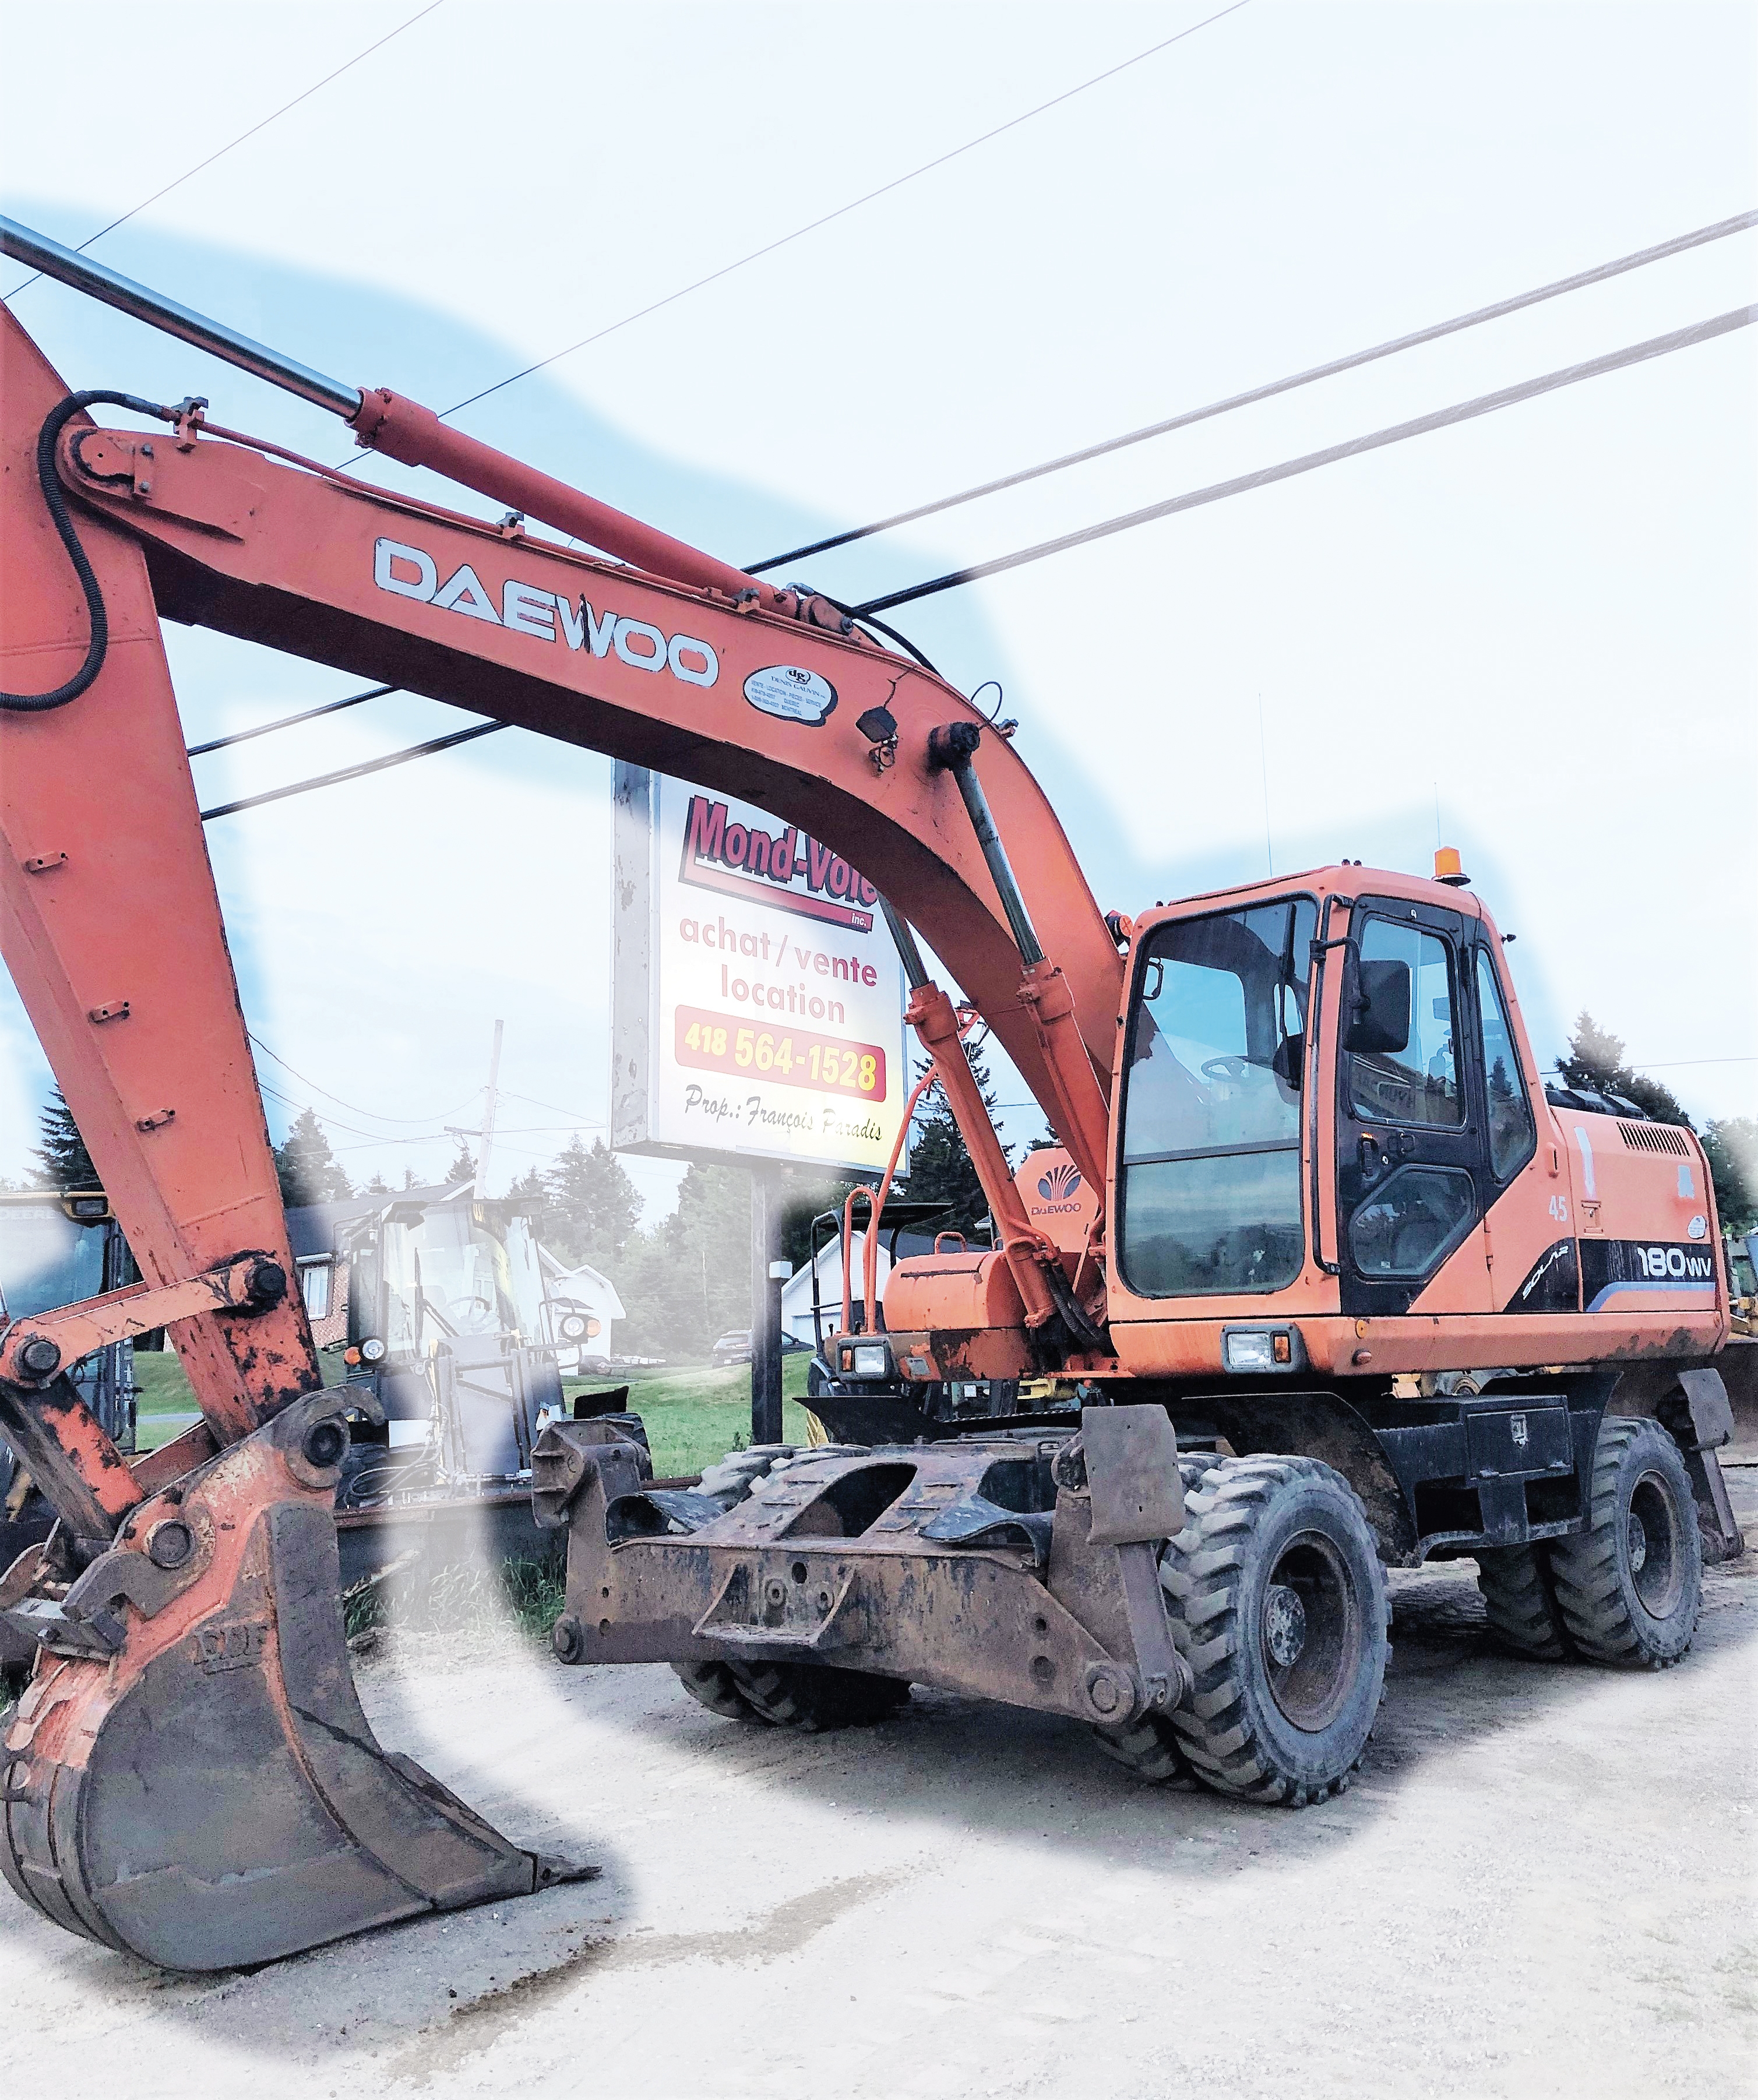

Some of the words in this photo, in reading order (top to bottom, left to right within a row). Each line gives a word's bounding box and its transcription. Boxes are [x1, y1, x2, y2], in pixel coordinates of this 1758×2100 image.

[374, 536, 720, 688] DAEWOO
[771, 676, 792, 687] DENIS
[851, 912, 867, 926] inc.
[721, 964, 845, 1024] location
[684, 1022, 727, 1056] 418
[734, 1027, 877, 1091] 564-1528
[746, 1096, 813, 1134] François
[822, 1108, 883, 1141] Paradis
[1031, 1202, 1081, 1215] DAEWOO
[1548, 1195, 1567, 1222] 45
[1522, 1245, 1569, 1300] SOLAR
